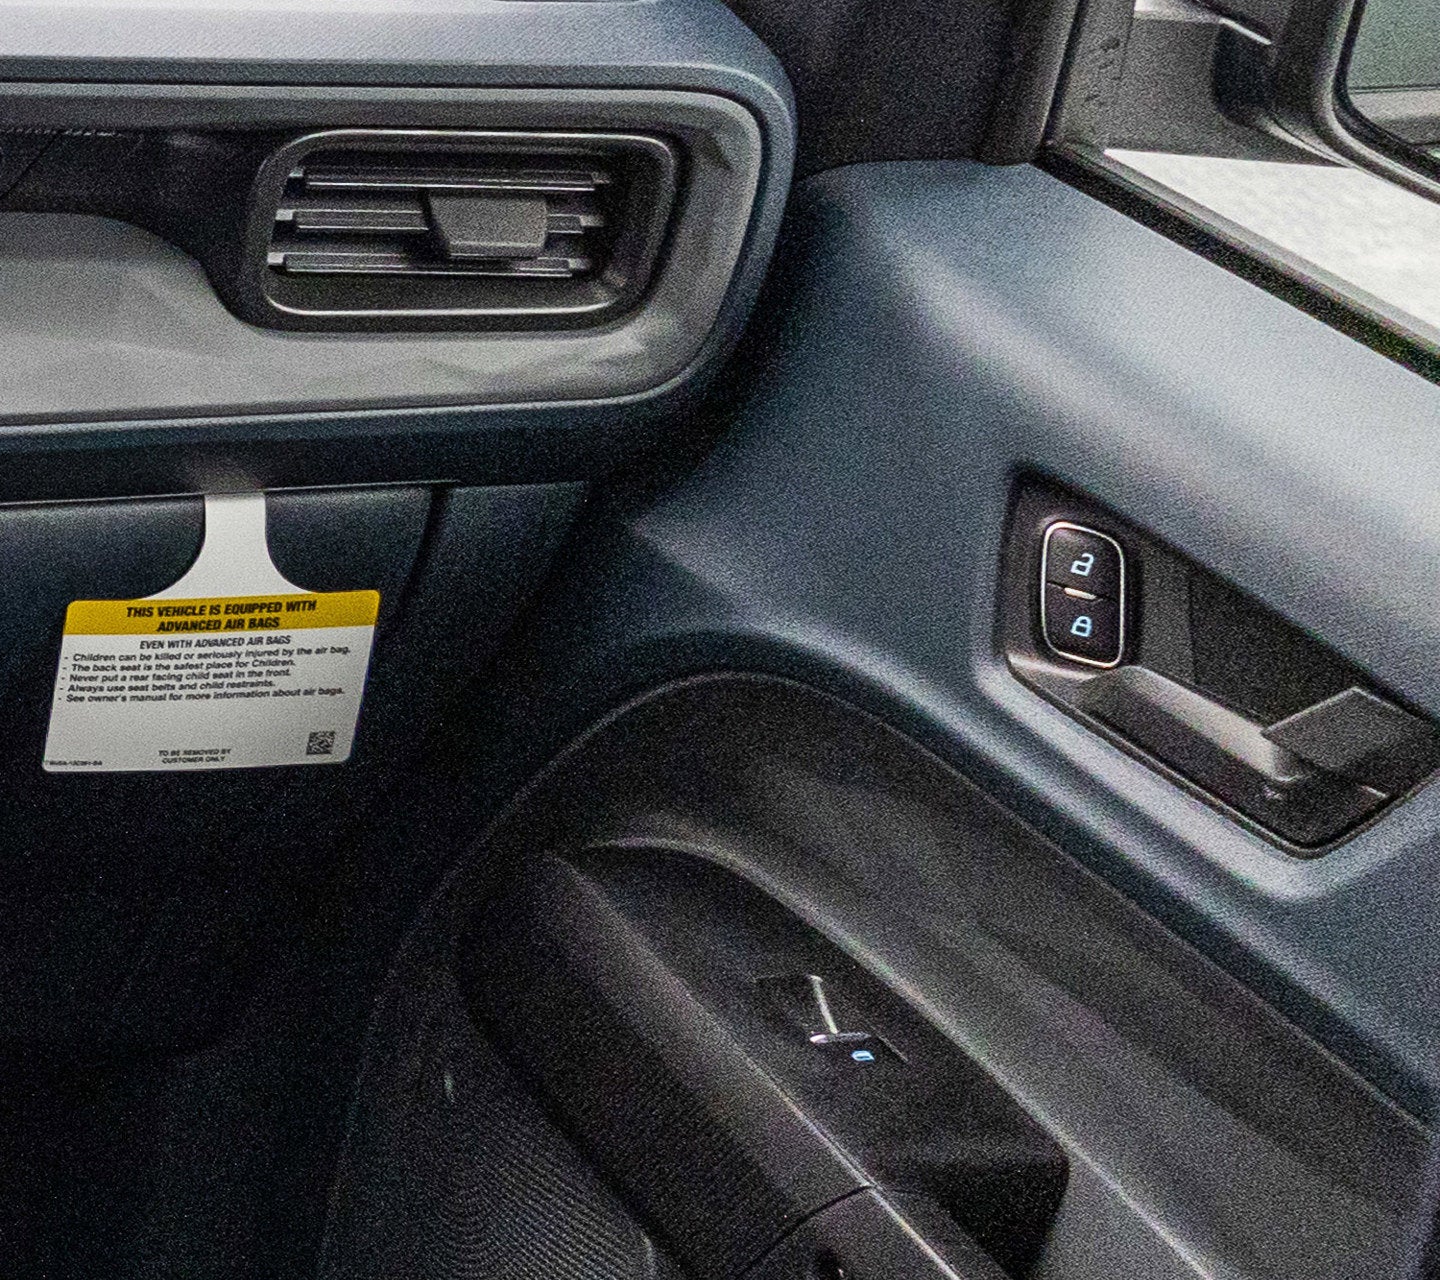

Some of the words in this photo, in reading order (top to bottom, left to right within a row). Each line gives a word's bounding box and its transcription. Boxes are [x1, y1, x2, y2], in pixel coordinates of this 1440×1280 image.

[126, 606, 153, 618] THIS
[158, 605, 206, 617] VEHICLE
[209, 604, 221, 616] IS
[224, 602, 282, 615] EQUIPPED
[285, 600, 317, 612] WITH
[156, 619, 221, 632] ADVANCED
[224, 618, 244, 630] AIR
[248, 616, 280, 629] BAGS
[140, 640, 164, 650] EVEN
[167, 638, 193, 649] WITH
[194, 636, 245, 648] ADVANCED
[246, 636, 263, 646] AIR
[266, 634, 291, 645] BAGS
[73, 653, 116, 662] Children
[140, 653, 152, 661] be
[154, 652, 181, 660] killed
[197, 650, 242, 660] seriously
[245, 649, 279, 658] injured
[281, 648, 295, 657] by
[296, 647, 312, 655] the
[314, 647, 328, 655] air
[330, 646, 351, 655] bag.
[71, 663, 90, 672] The
[92, 663, 117, 672] back
[119, 663, 141, 671] seat
[143, 663, 153, 671] is
[155, 662, 171, 670] the
[173, 662, 204, 670] safest
[205, 661, 233, 670] place
[235, 660, 249, 668] for
[251, 659, 295, 667] Children.
[69, 674, 99, 682] Never
[101, 674, 119, 682] put
[151, 673, 183, 682] facing
[185, 672, 209, 680] child
[212, 671, 233, 679] seat
[235, 670, 245, 678] in
[67, 684, 104, 693] Always
[127, 684, 149, 692] seat
[151, 683, 176, 691] belts
[199, 681, 224, 690] child
[66, 694, 85, 702] See
[87, 694, 127, 702] owner's
[129, 693, 167, 701] manual
[168, 692, 183, 700] for
[213, 690, 270, 700] information
[272, 688, 301, 697] about
[302, 688, 316, 696] air
